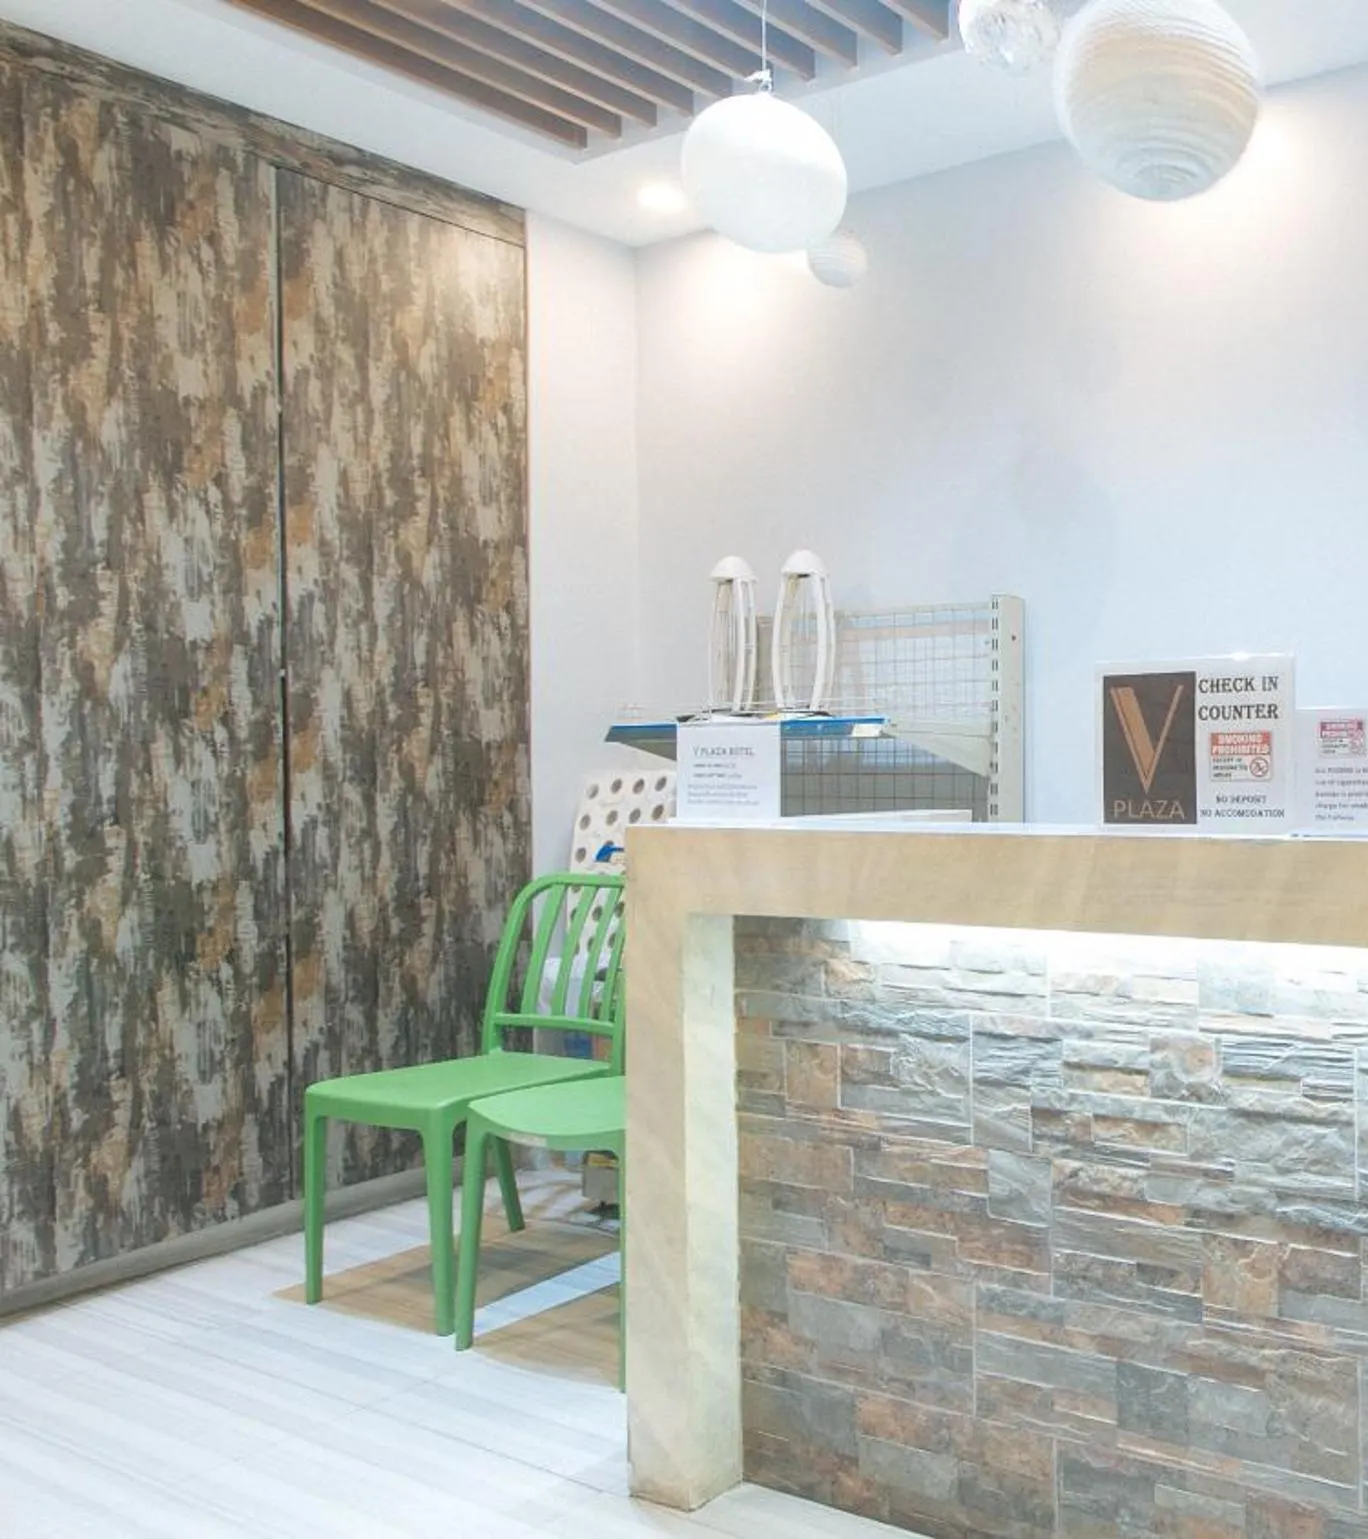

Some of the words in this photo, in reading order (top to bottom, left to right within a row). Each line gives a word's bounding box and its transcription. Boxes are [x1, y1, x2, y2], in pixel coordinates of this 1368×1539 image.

[1199, 677, 1255, 693] CHECK
[1262, 676, 1279, 692] IN
[1198, 704, 1280, 721] COUNTER
[1113, 800, 1185, 819] PLAZA
